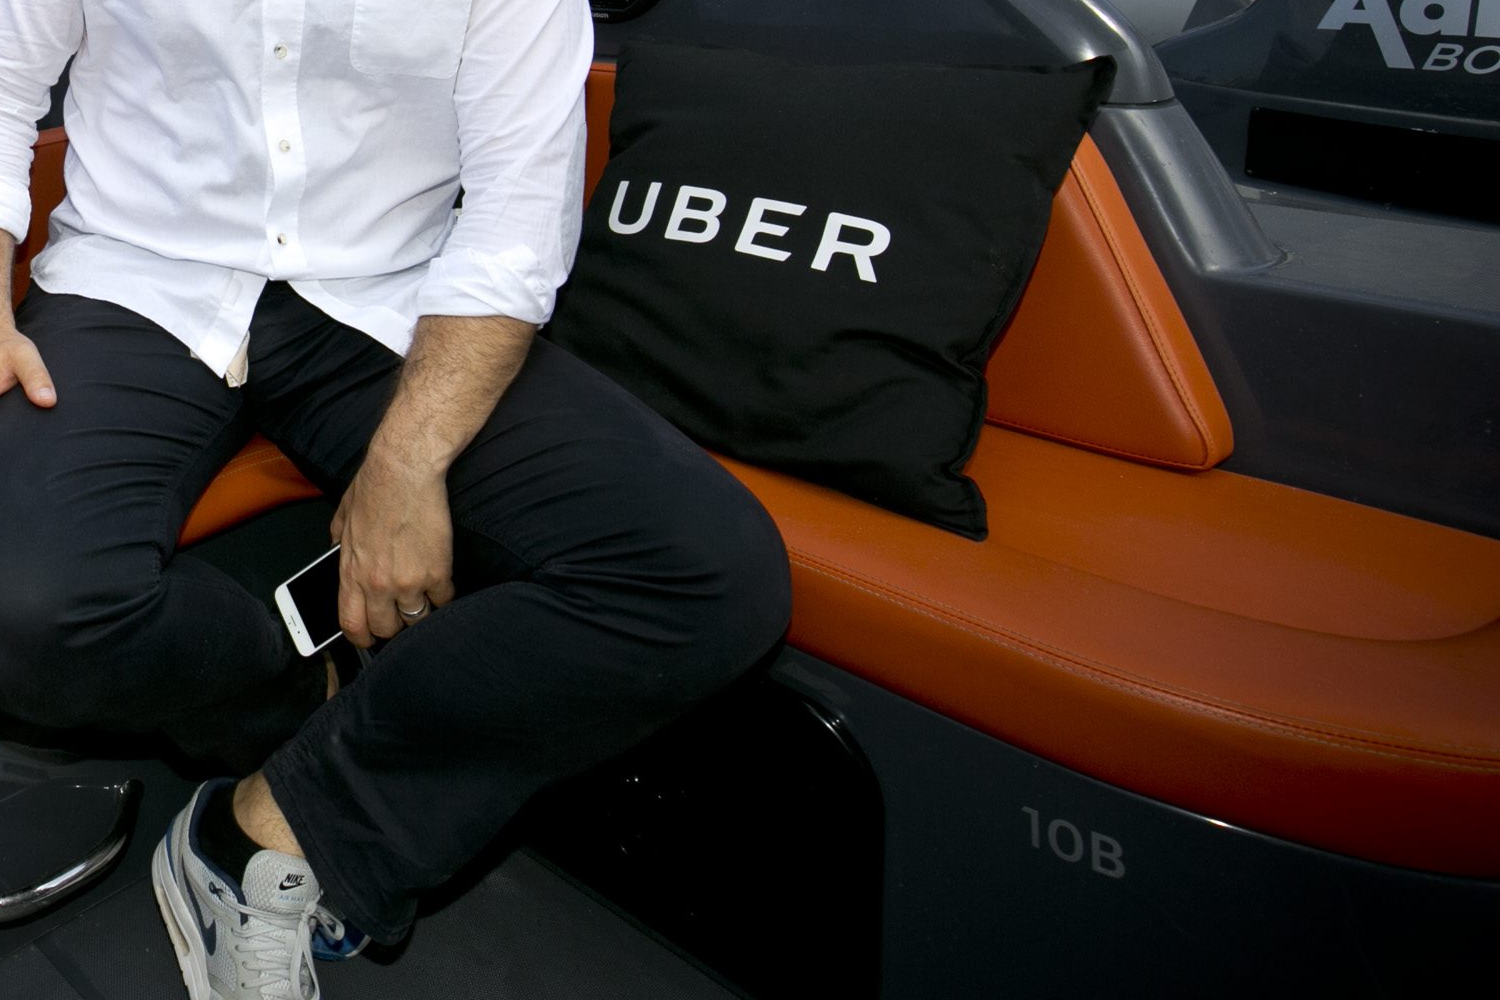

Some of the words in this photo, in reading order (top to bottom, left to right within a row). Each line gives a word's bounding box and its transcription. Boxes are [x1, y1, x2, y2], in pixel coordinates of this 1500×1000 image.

[608, 180, 891, 283] UBER
[284, 873, 306, 885] NIKE
[1020, 805, 1127, 880] 10B
